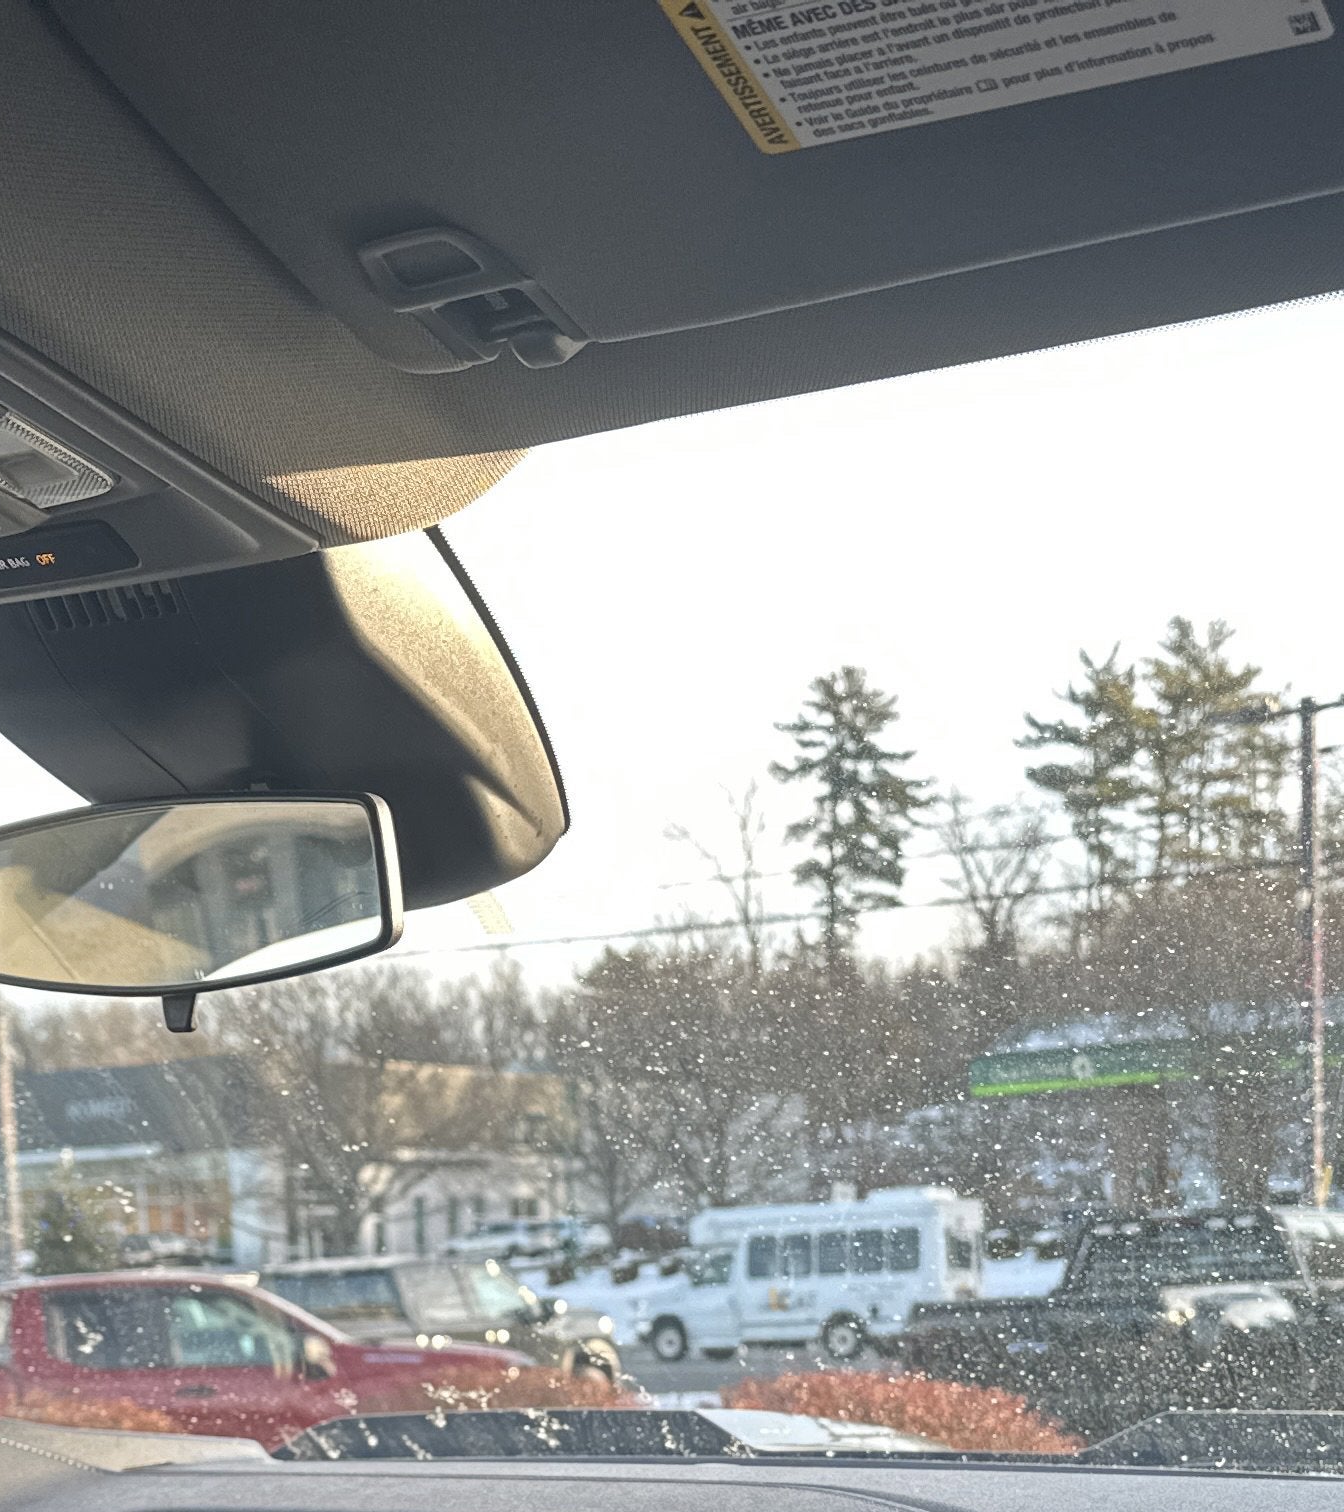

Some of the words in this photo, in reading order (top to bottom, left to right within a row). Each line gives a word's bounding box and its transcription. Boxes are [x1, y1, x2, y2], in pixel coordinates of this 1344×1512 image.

[730, 3, 748, 15] air
[732, 20, 788, 39] MÊME
[789, 4, 837, 26] AVEC
[837, 0, 876, 15] DES
[753, 38, 778, 51] Les
[779, 28, 826, 45] enfants
[826, 15, 879, 36] peuvent
[879, 10, 906, 23] être
[907, 3, 937, 16] tués
[762, 54, 780, 64] Le
[781, 46, 816, 60] siège
[816, 36, 859, 53] arrière
[860, 30, 881, 43] est
[881, 18, 936, 38] l'endroit
[937, 16, 951, 25] le
[952, 9, 982, 24] plus
[982, 2, 1004, 16] sûr
[771, 67, 791, 77] Ne
[791, 57, 834, 76] jamais
[834, 49, 873, 65] placer
[886, 36, 931, 52] l'avant
[932, 33, 950, 43] un
[951, 17, 1011, 39] dispositif
[1013, 14, 1031, 25] de
[1032, 0, 1101, 23] protection
[779, 72, 823, 88] faisant
[823, 67, 851, 80] face
[788, 85, 842, 102] Toujours
[843, 75, 884, 91] utiliser
[886, 71, 908, 82] les
[908, 58, 968, 77] ceintures
[969, 53, 987, 64] de
[1043, 36, 1057, 48] et
[1059, 33, 1080, 44] les
[1083, 16, 1156, 39] ensembles
[1158, 11, 1176, 22] de
[691, 26, 788, 145] AVERTISSEMENT
[797, 97, 843, 113] retenue
[875, 81, 920, 97] enfant.
[803, 114, 828, 126] Voir
[830, 112, 844, 121] le
[844, 104, 880, 118] Guide
[882, 100, 900, 111] du
[900, 86, 973, 108] propriétaire
[1033, 66, 1063, 81] plus
[1064, 46, 1152, 72] d'information
[1154, 42, 1165, 53] à
[1166, 33, 1215, 52] propos
[812, 127, 835, 137] des
[837, 120, 865, 132] sacs
[867, 107, 934, 128] gonflables.
[8, 556, 31, 569] BAG
[35, 552, 56, 566] OFF
